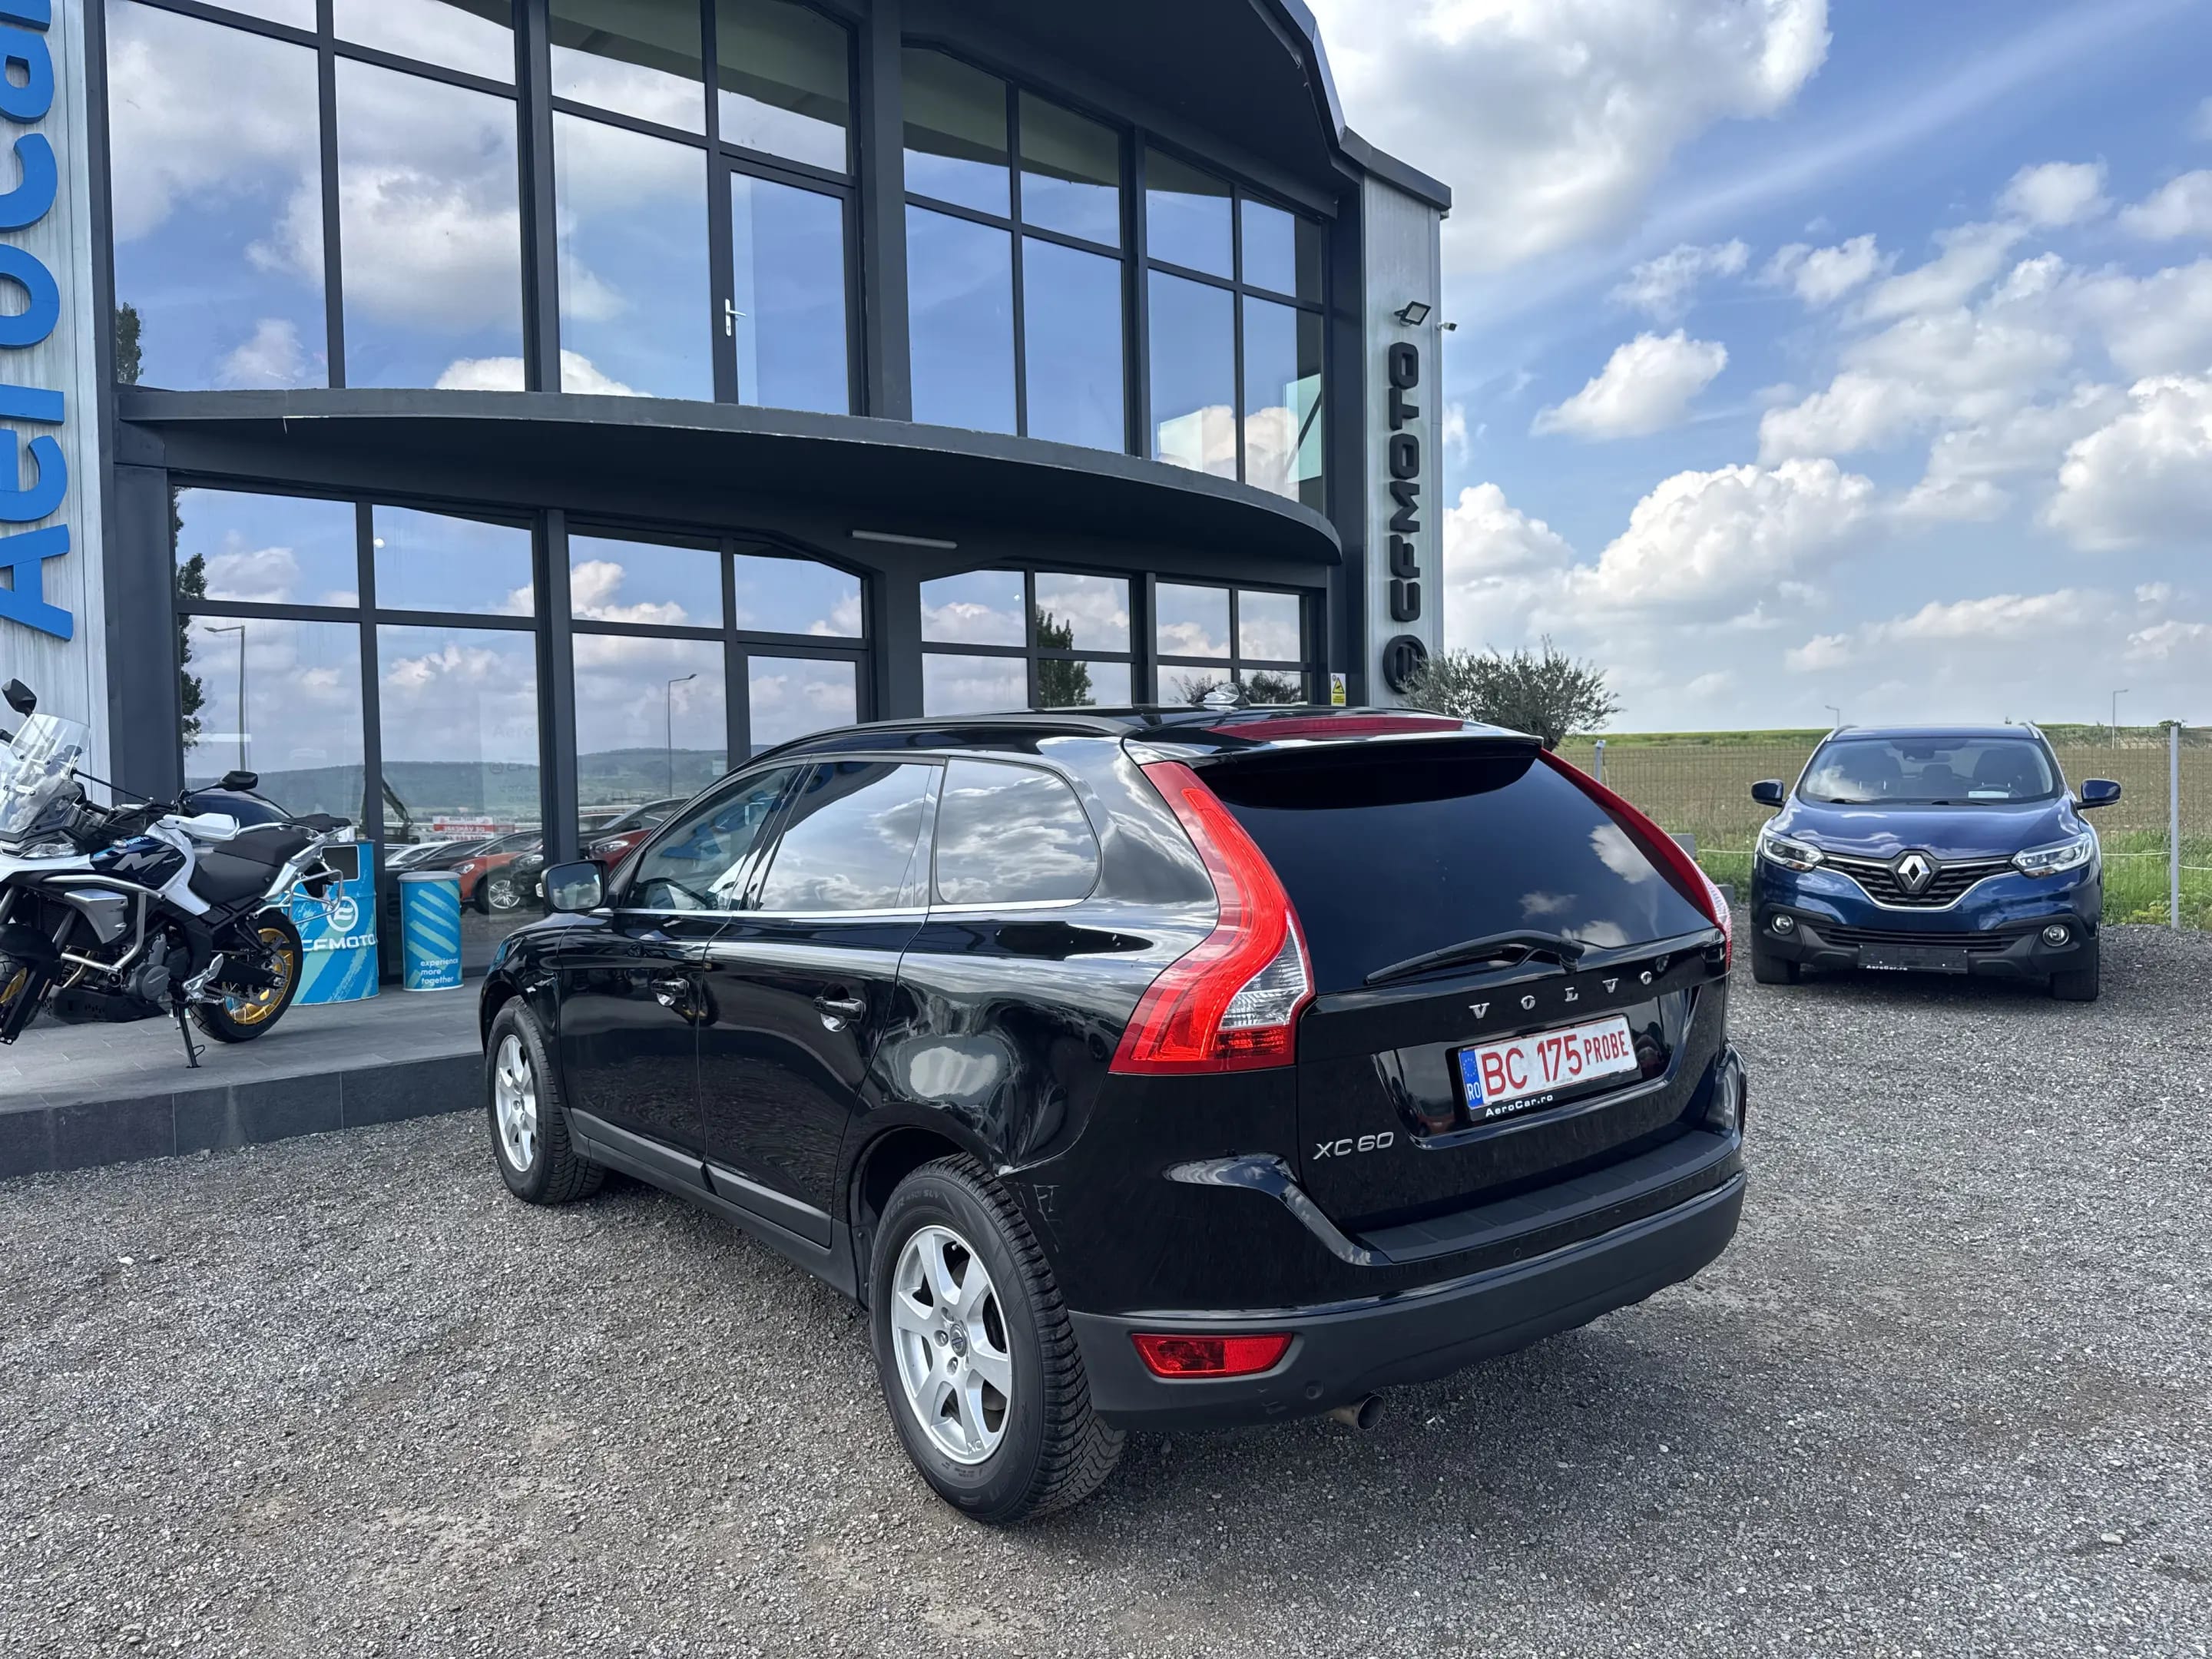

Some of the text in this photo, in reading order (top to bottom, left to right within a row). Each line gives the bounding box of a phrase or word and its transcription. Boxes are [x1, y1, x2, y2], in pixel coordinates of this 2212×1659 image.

[1389, 342, 1420, 622] CFMOTO
[302, 933, 377, 952] CFMOTO
[421, 975, 454, 986] together
[1468, 971, 1652, 1019] VOLVO
[1481, 1030, 1630, 1097] BC 175 PROBE
[1467, 1081, 1482, 1101] RO
[1485, 1094, 1554, 1117] AeroCar.ro
